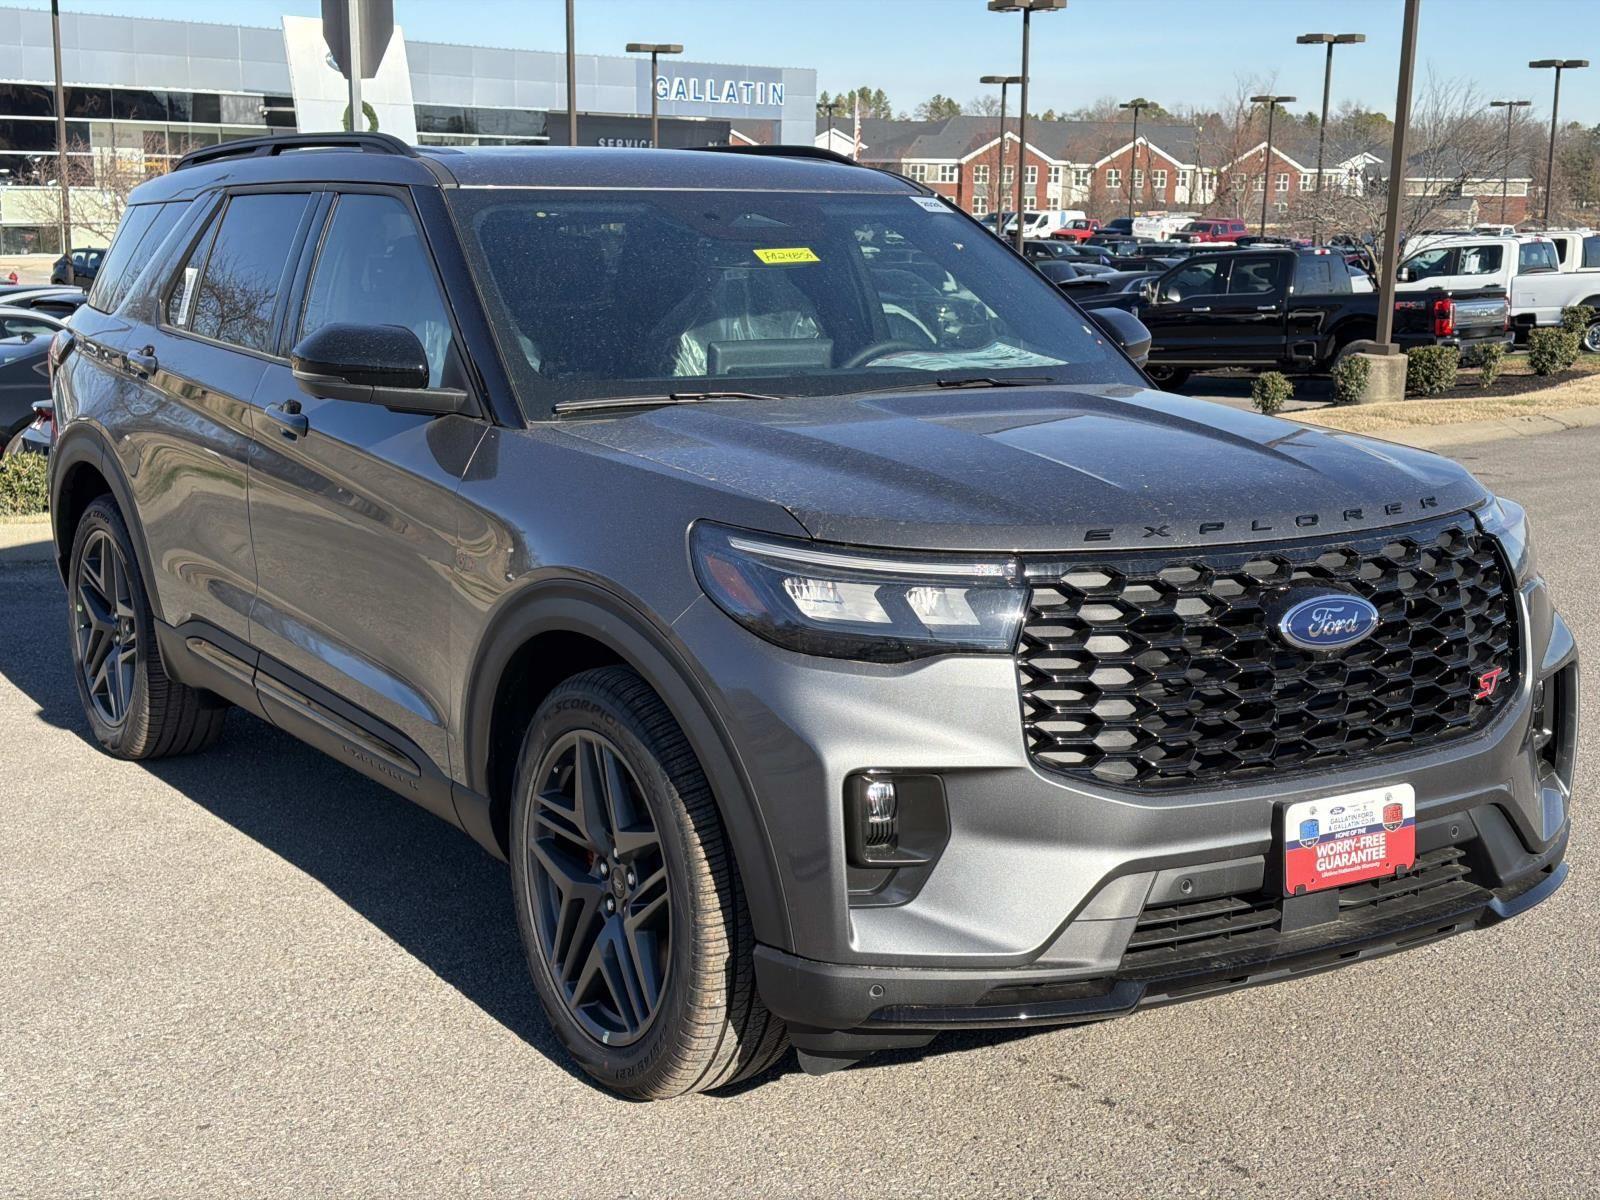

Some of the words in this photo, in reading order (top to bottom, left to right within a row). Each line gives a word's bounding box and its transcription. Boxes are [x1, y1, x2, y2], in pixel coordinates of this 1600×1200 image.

[655, 75, 785, 105] GALLATIN
[1084, 496, 1439, 542] EXPLORER
[1308, 606, 1359, 638] Ford
[1474, 666, 1503, 700] ST
[1330, 814, 1357, 825] GALLATIN
[1335, 830, 1351, 839] HOME
[1351, 829, 1359, 837] OF
[1359, 827, 1367, 835] THE
[1315, 832, 1386, 858] WORRY-FREE
[1316, 846, 1386, 872] GUARANTEE
